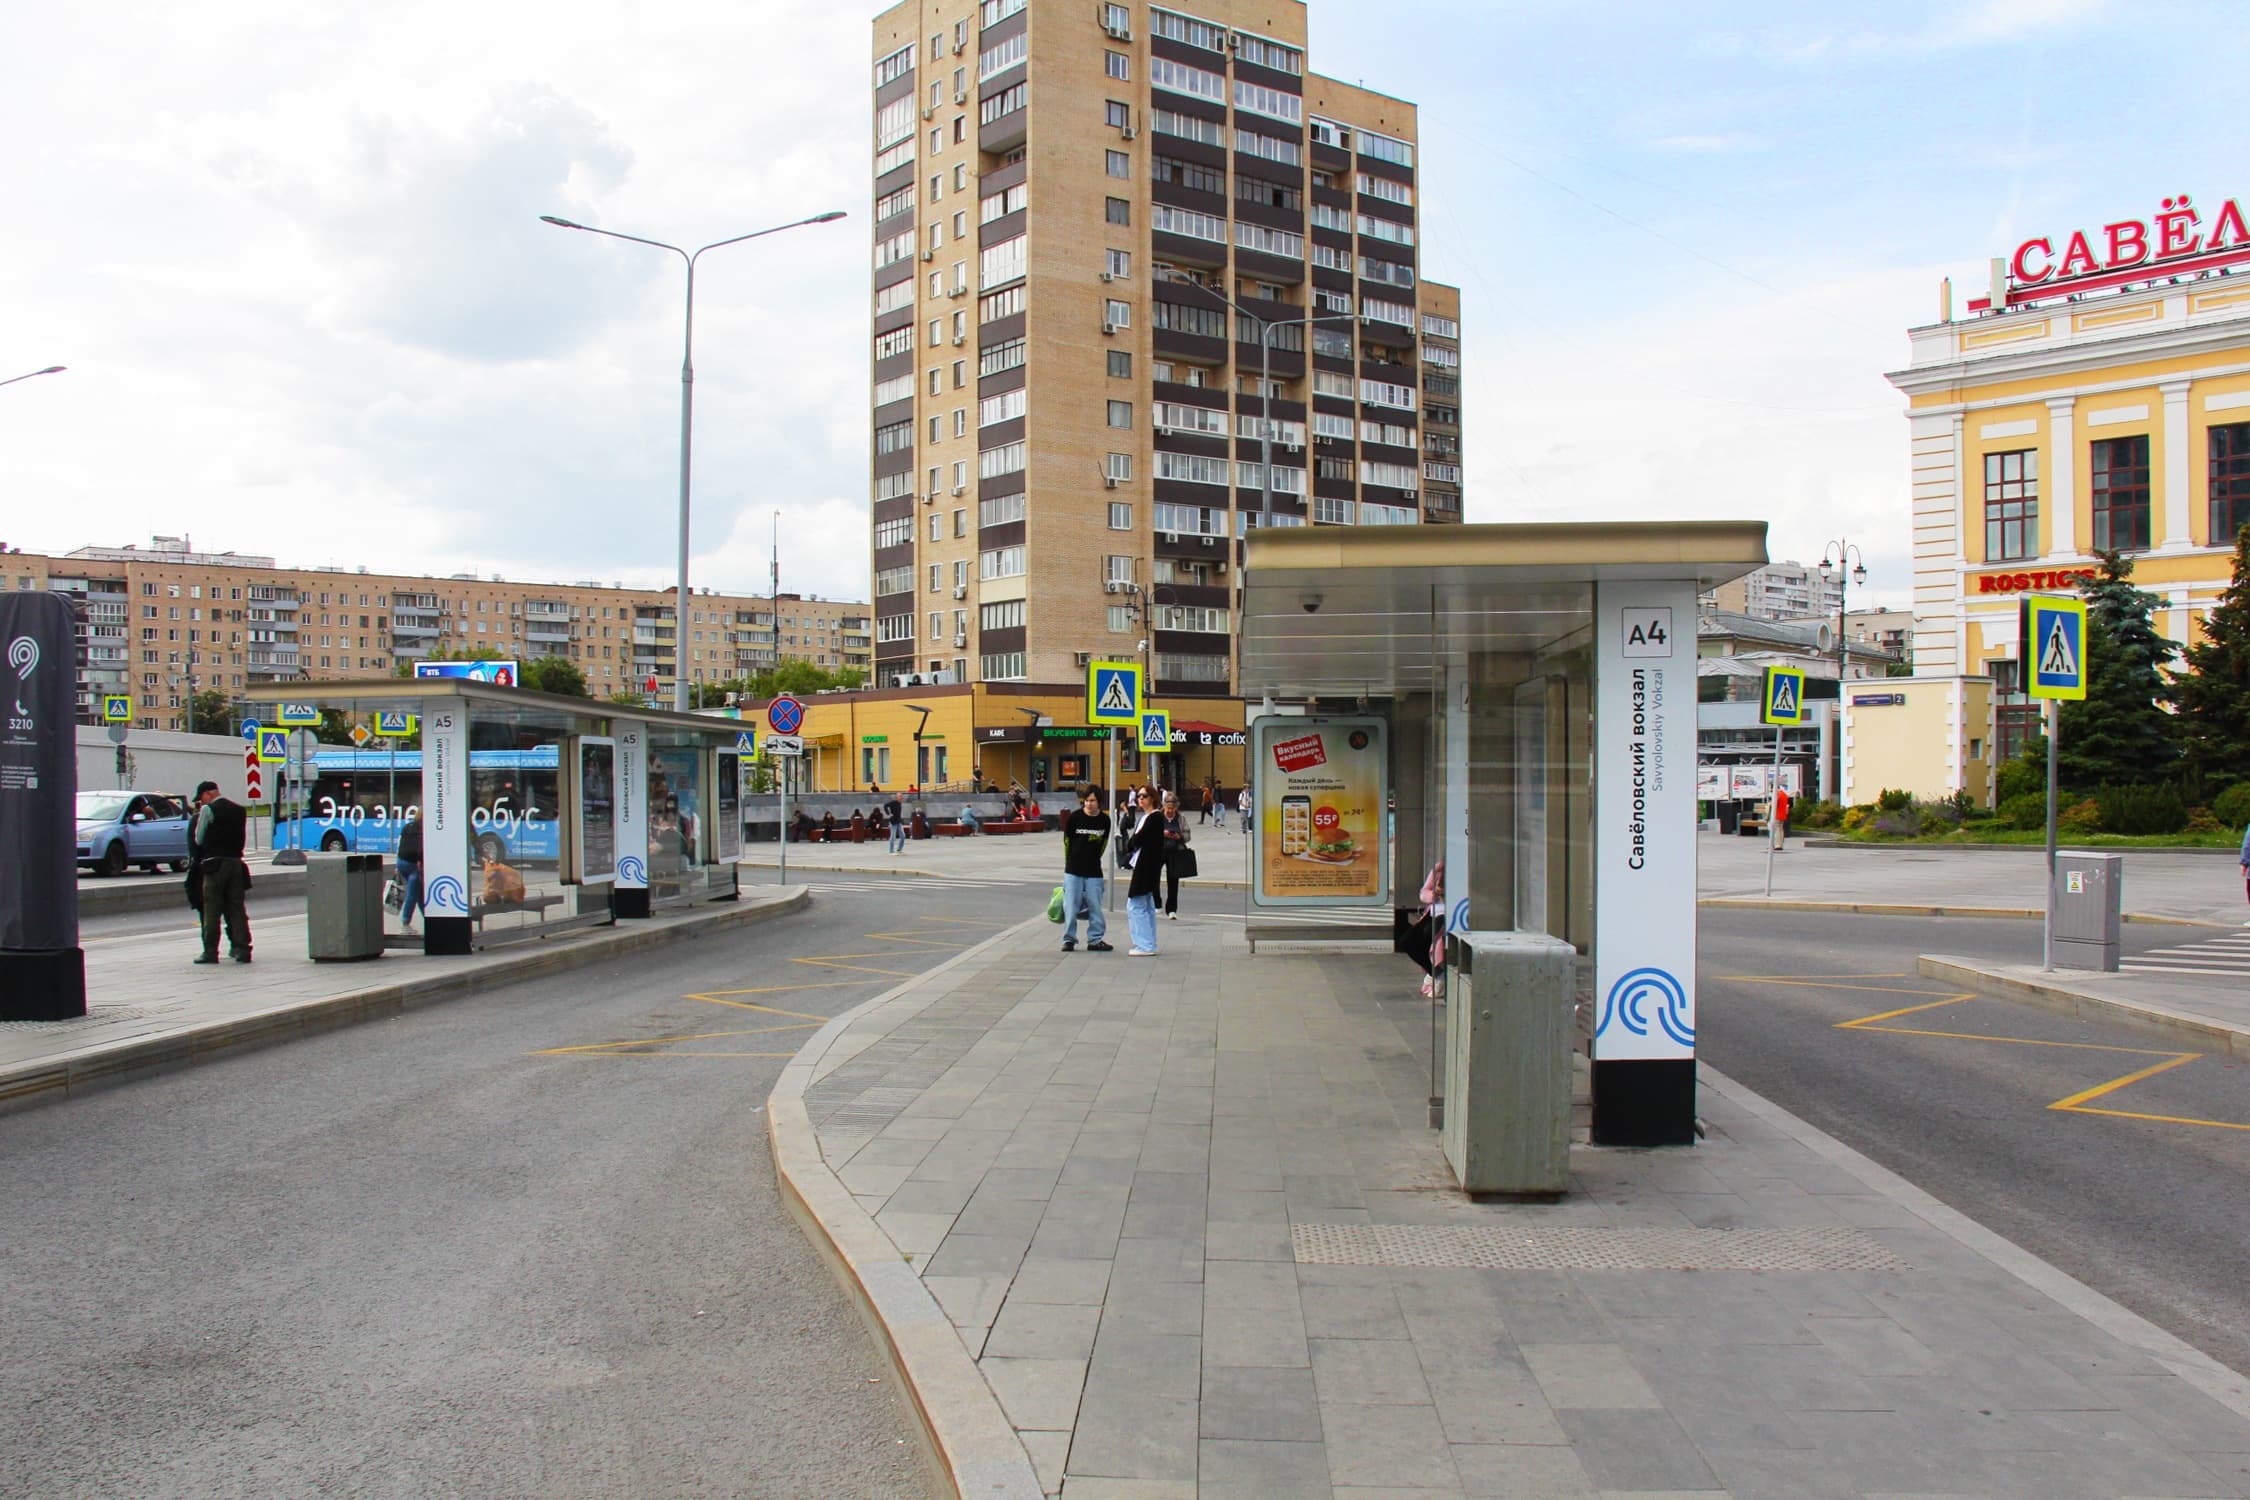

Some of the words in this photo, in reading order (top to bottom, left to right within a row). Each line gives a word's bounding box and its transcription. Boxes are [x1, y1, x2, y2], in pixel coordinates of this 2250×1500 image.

[1628, 620, 1667, 646] А4
[1652, 669, 1663, 709] Vokzal
[1633, 668, 1645, 735] вокзал
[9, 718, 34, 730] 3210
[435, 716, 453, 728] А5
[989, 729, 1005, 737] КАФЕ
[1169, 729, 1187, 742] ofix
[1218, 732, 1246, 745] cofix
[1277, 738, 1319, 755] Вкусный
[1279, 747, 1320, 762] календарь
[1652, 713, 1664, 791] Savyolovskiy
[320, 796, 365, 828] Это
[1628, 742, 1645, 870] Савёловский
